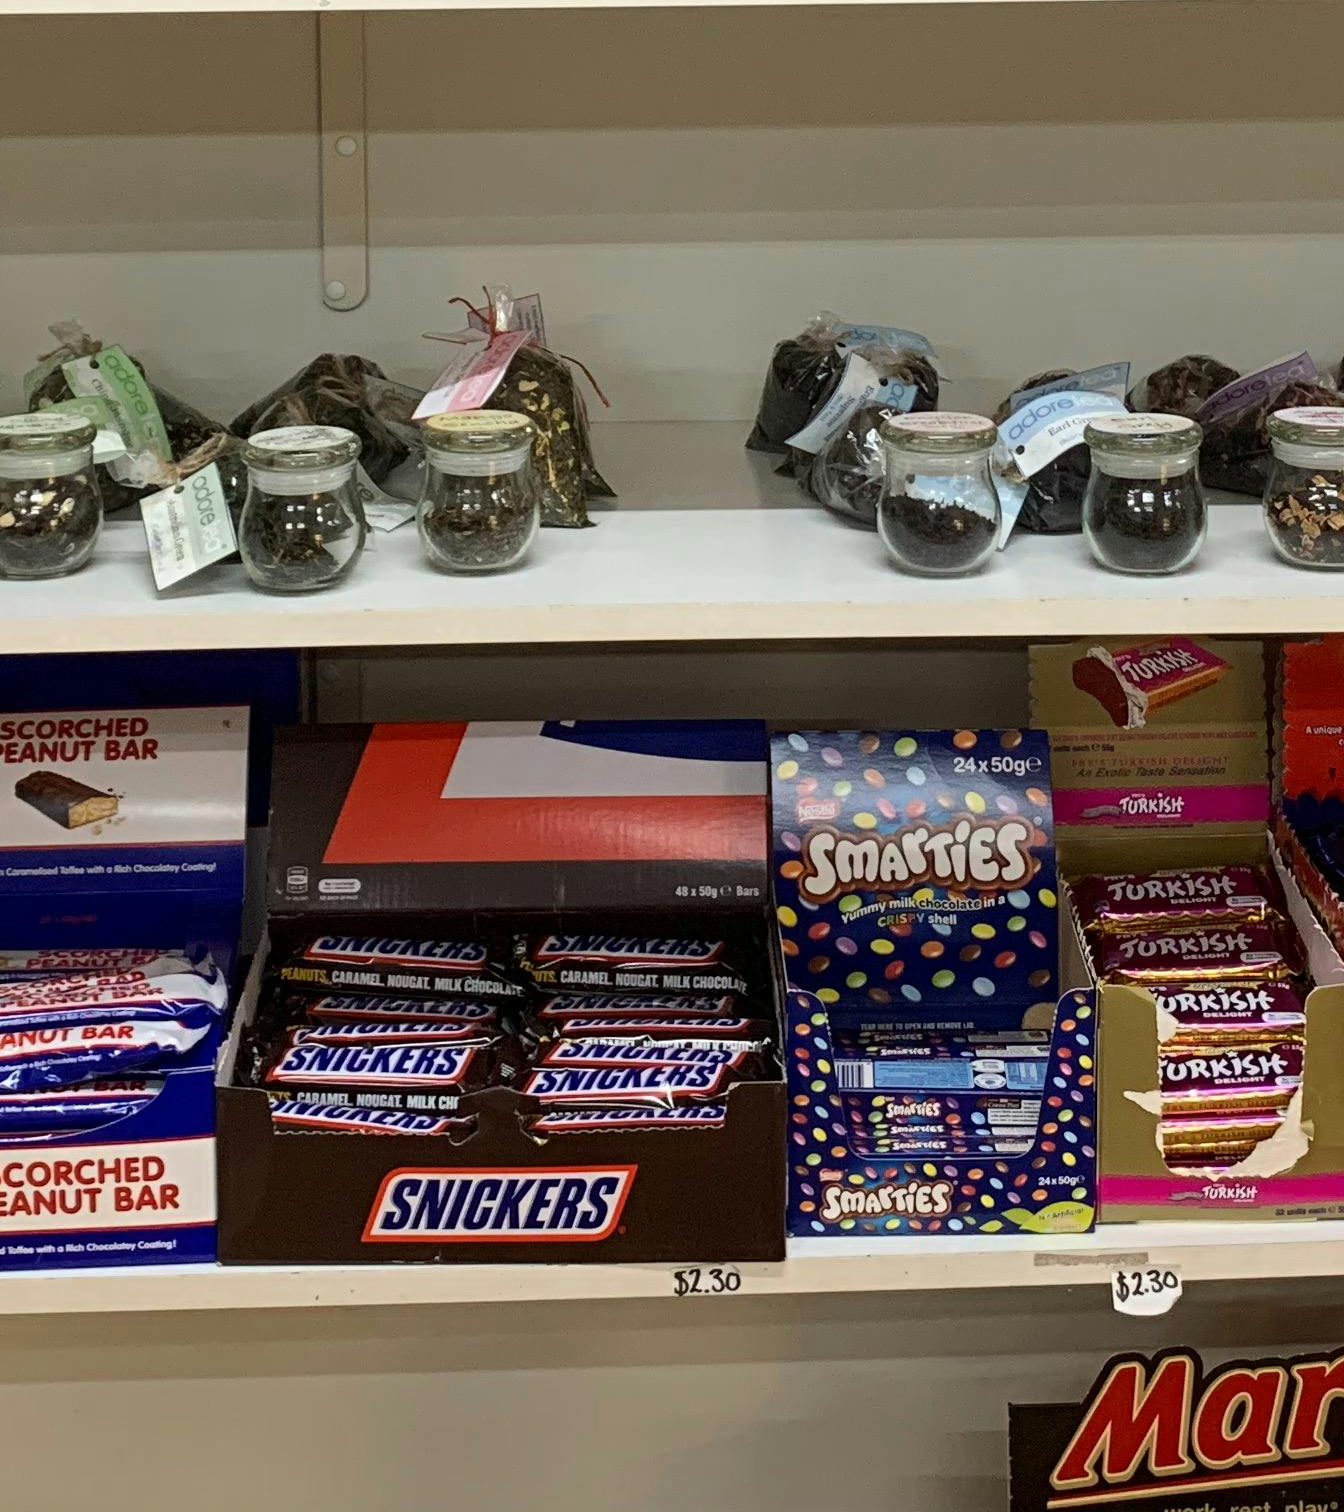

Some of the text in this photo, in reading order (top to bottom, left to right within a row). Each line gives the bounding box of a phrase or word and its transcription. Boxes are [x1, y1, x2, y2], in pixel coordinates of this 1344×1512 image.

[1121, 647, 1197, 684] TURKISH
[0, 717, 150, 741] SCORCHED
[104, 739, 159, 761] BAR
[1119, 793, 1184, 815] TURKISH
[675, 884, 688, 897] 48
[698, 884, 717, 899] 50g
[736, 884, 760, 897] Bars
[1107, 872, 1238, 902] TURKISH
[841, 896, 1005, 925] Yummy milk chocolate in a
[1171, 895, 1216, 905] DELIGHT
[928, 913, 957, 925] shell
[1119, 930, 1253, 960] TURKISH
[1183, 952, 1230, 960] DELIGHT
[434, 977, 525, 997] MILK CHOCOLATE
[663, 975, 748, 996] MILK CHOCOLATE
[1158, 987, 1275, 1014] URKISH
[1203, 1010, 1253, 1018] DELIGHT
[81, 1026, 134, 1040] BAR
[281, 1047, 464, 1075] SNICKERS
[533, 1063, 719, 1094] SNICKERS
[1214, 1076, 1265, 1086] DELIGHT
[407, 1095, 436, 1109] MILK
[114, 1183, 180, 1212] BAR
[1202, 1184, 1257, 1201] TURKISH
[381, 1177, 621, 1231] SNICKERS
[7, 1244, 34, 1255] Toffee
[36, 1243, 55, 1254] with
[65, 1241, 84, 1252] Rich
[86, 1240, 135, 1253] Chocolatey
[137, 1239, 177, 1251] Coating!
[674, 1269, 742, 1296] $2.30
[1115, 1269, 1179, 1303] $2.30
